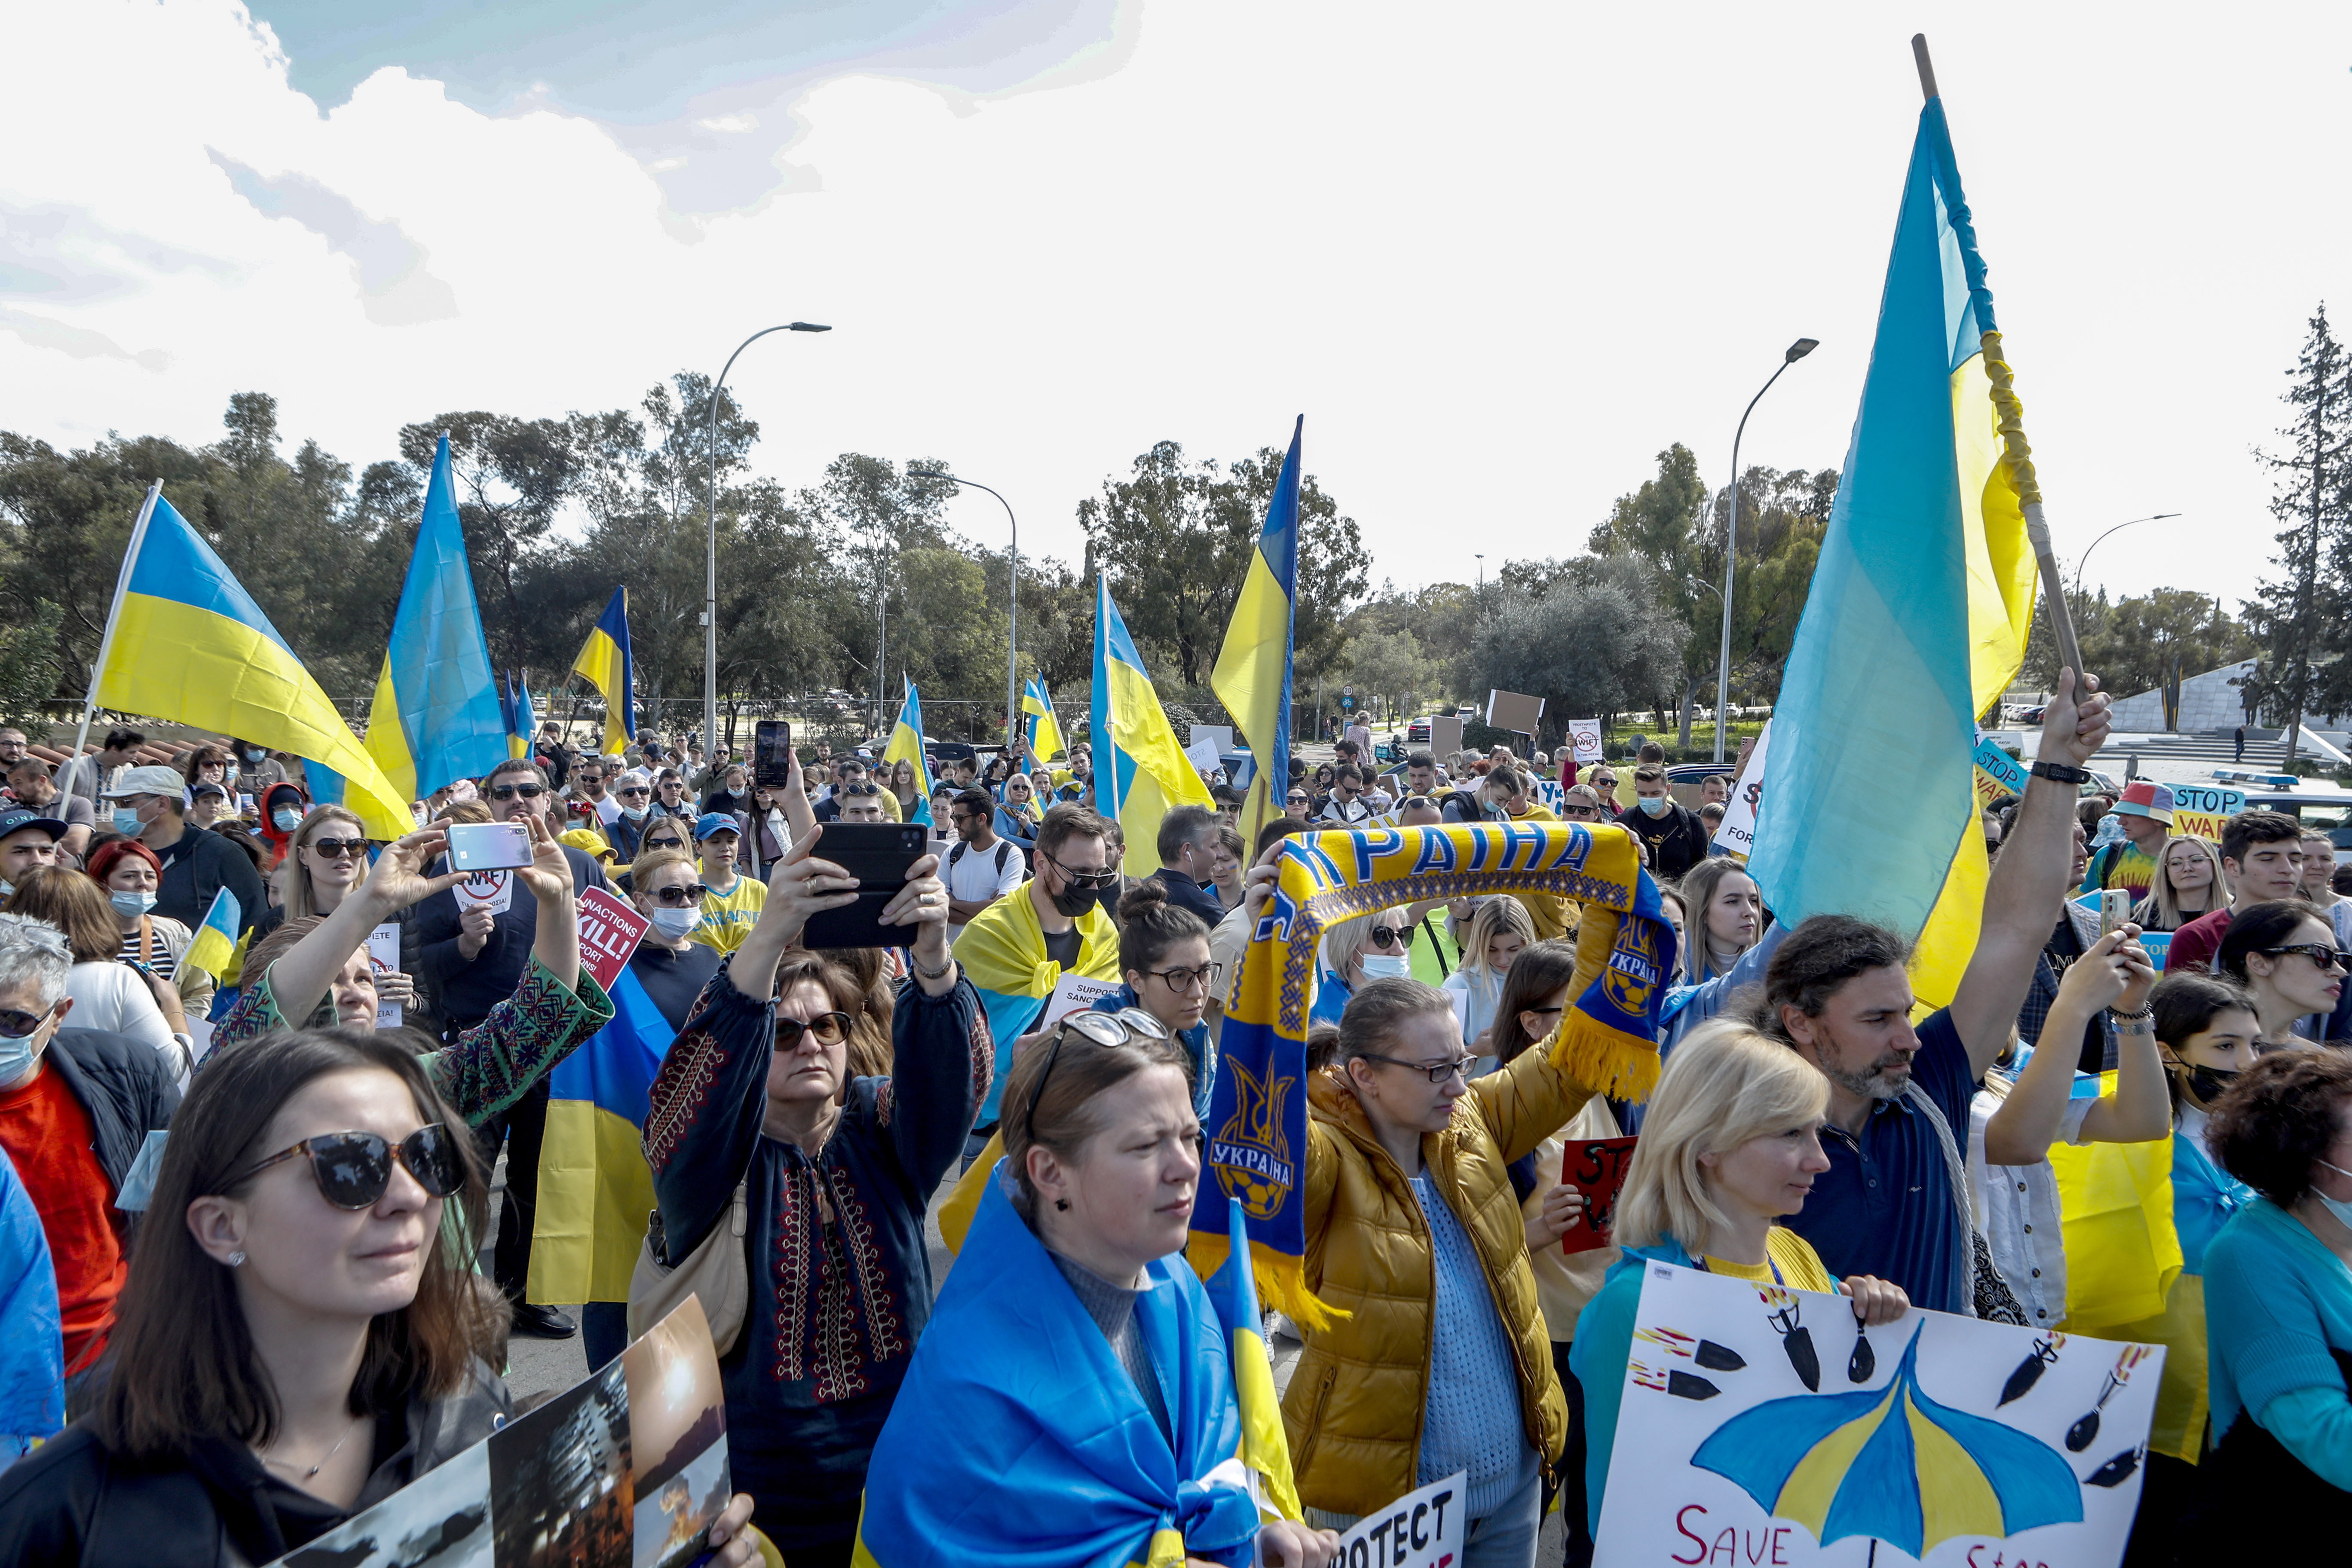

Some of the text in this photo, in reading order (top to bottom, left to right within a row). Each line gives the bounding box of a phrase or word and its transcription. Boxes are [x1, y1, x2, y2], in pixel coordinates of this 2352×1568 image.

[1977, 752, 2018, 783] STOP
[2175, 789, 2238, 814] STOP
[1727, 826, 1754, 844] FOR
[457, 870, 507, 885] WIF
[584, 898, 638, 938] INACTIONS
[577, 913, 631, 961] KILL!
[2142, 944, 2170, 955] TOP
[579, 942, 604, 963] PORT
[1066, 992, 1099, 1003] SANCT
[1213, 1144, 1289, 1186] УКРАЇНА
[1326, 1490, 1452, 1568] ROTECT
[1671, 1504, 1792, 1566] SAVE
